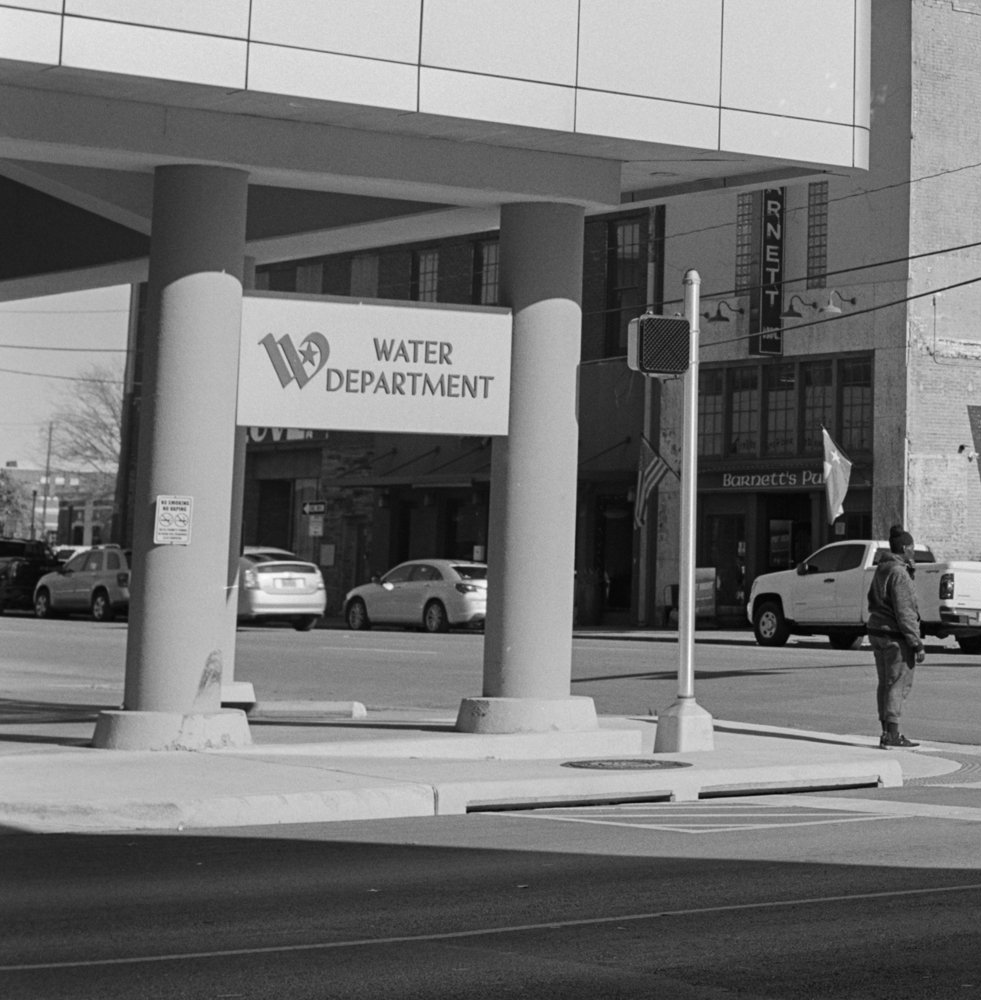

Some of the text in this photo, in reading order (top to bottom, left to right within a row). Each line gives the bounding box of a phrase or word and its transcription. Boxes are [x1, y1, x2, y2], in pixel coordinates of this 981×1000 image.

[764, 188, 782, 306] RNETT
[373, 338, 453, 364] WATER
[326, 368, 494, 399] DEPARTMENT
[723, 472, 797, 487] Barnett's
